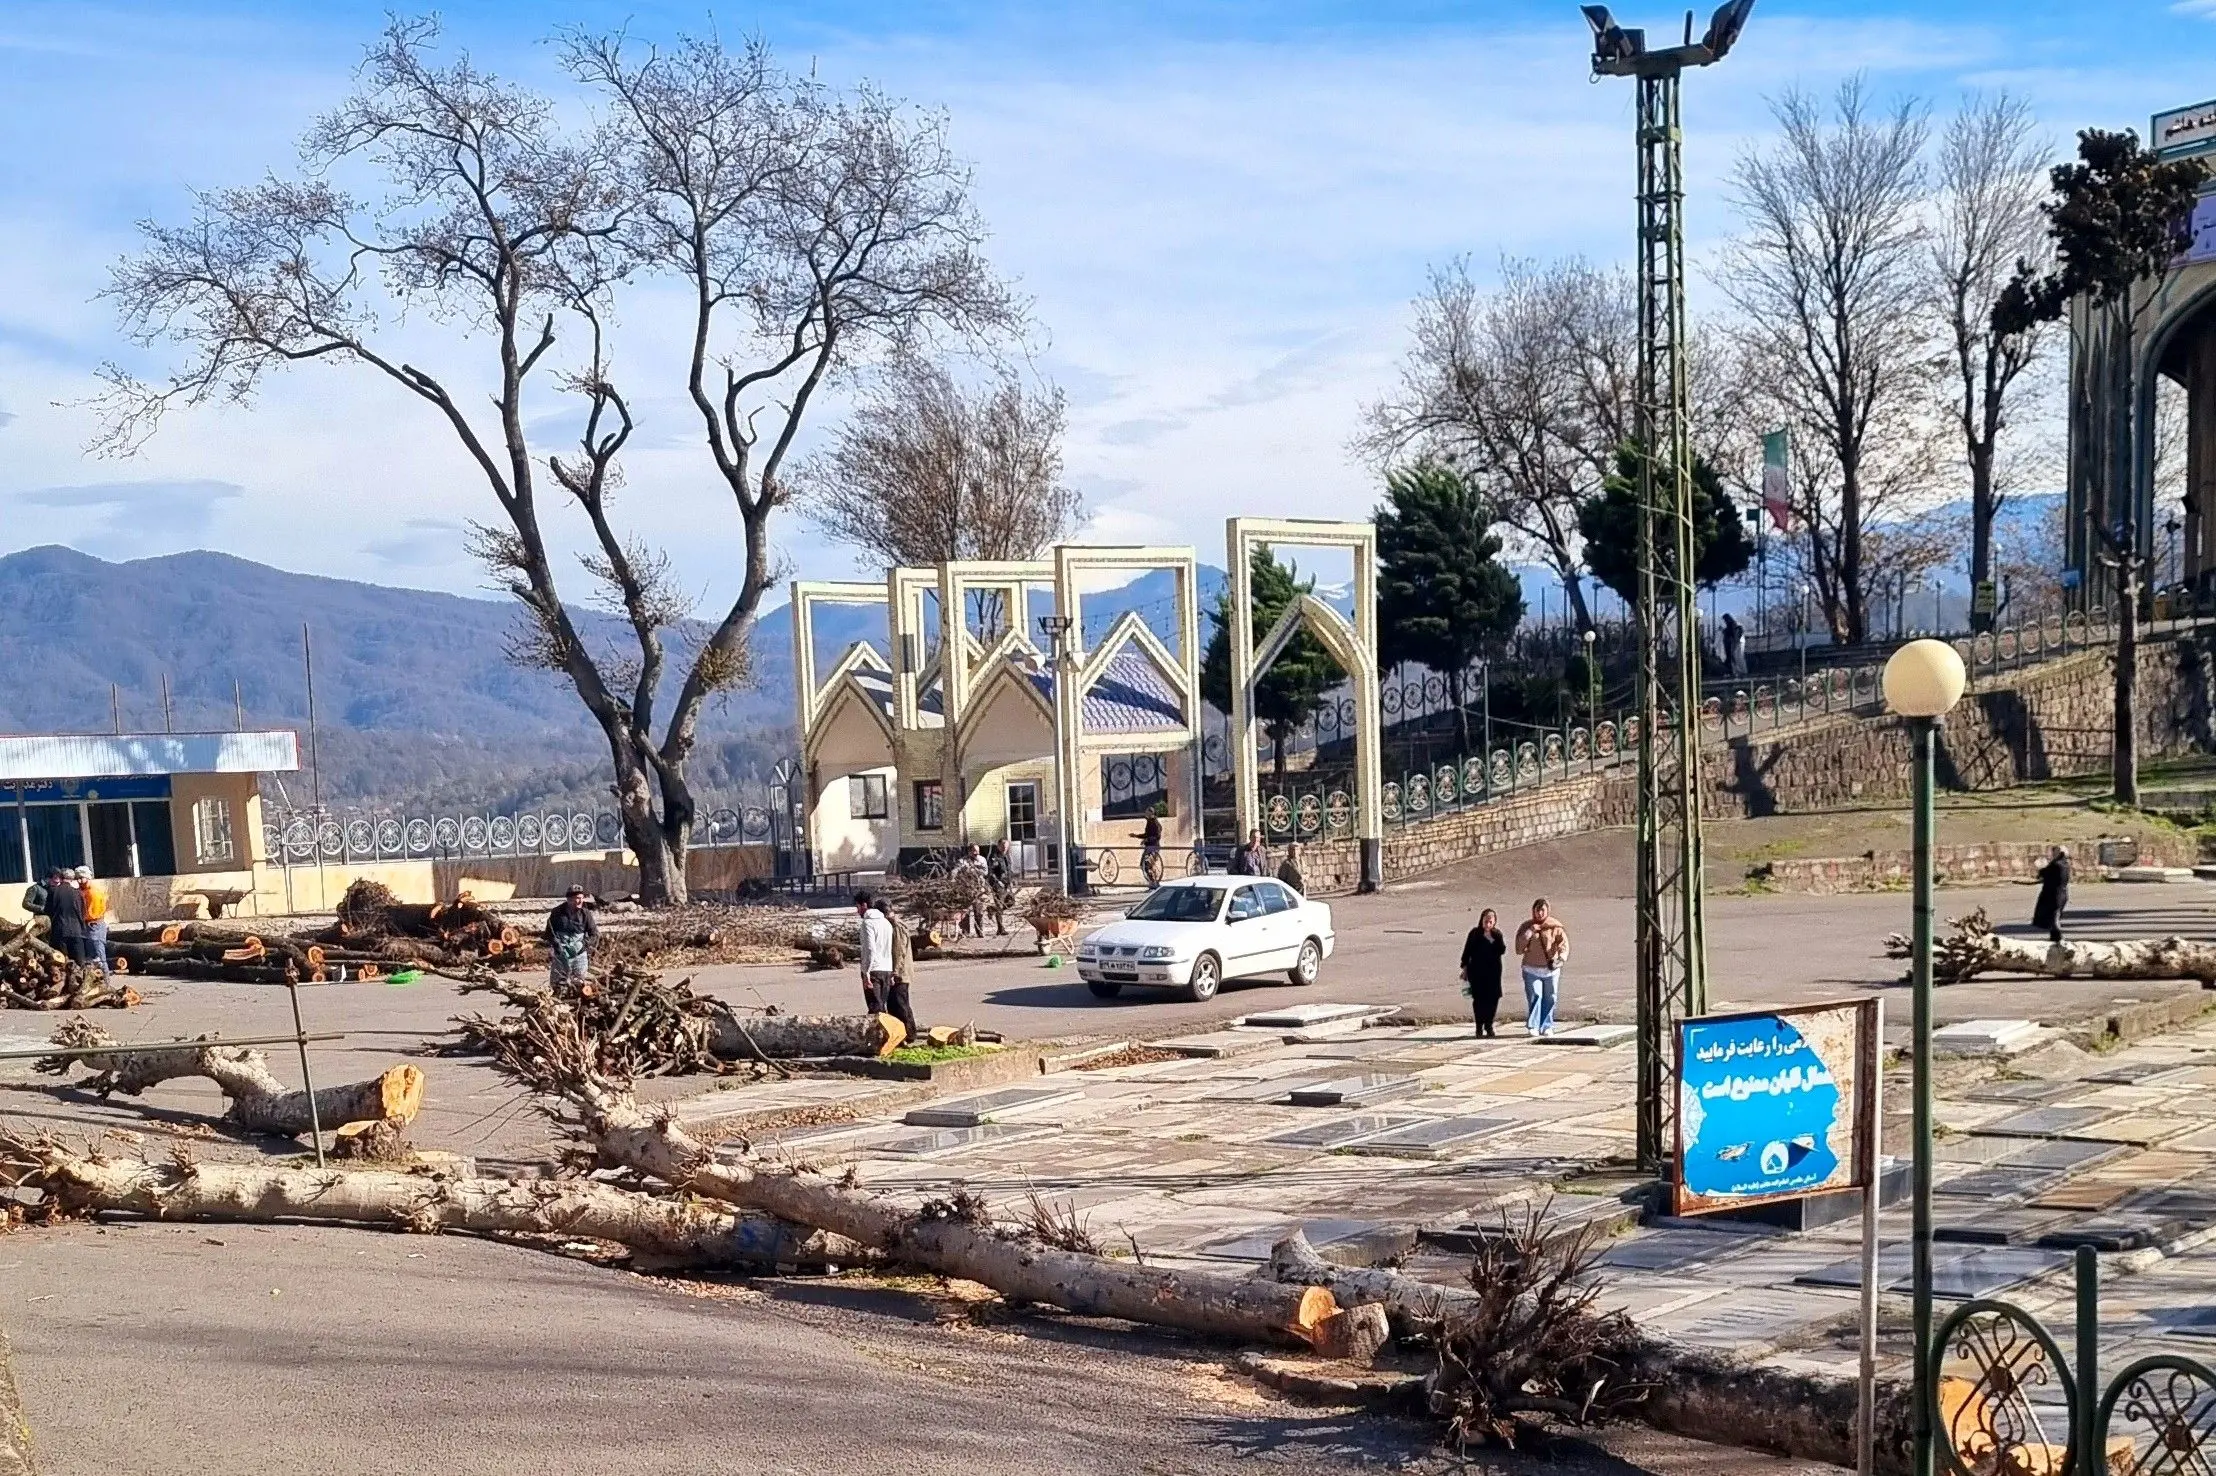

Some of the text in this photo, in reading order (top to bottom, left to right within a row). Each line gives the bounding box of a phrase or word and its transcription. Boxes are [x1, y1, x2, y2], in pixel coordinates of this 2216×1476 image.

[1695, 1038, 1737, 1063] فرمایید
[1736, 1037, 1772, 1058] رعایت
[1771, 1034, 1783, 1056] را
[1701, 1074, 1732, 1099] است
[1730, 1074, 1769, 1101] ممنوع
